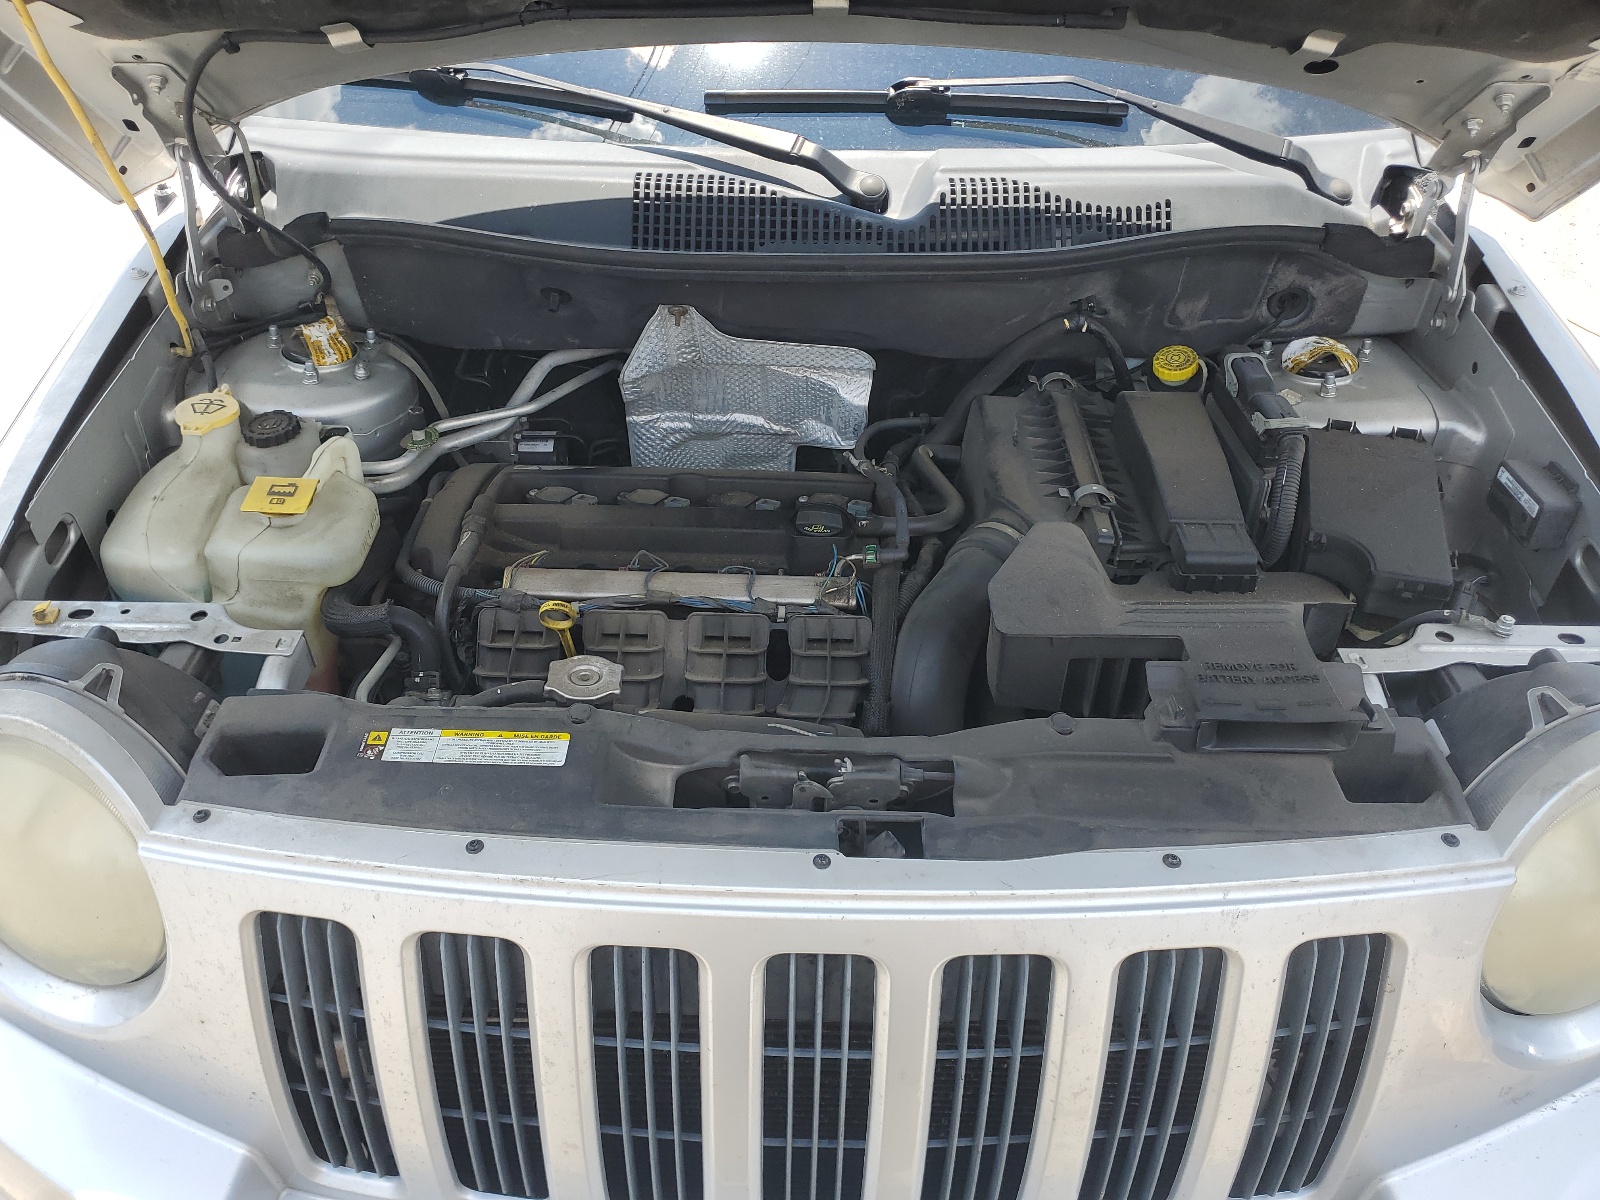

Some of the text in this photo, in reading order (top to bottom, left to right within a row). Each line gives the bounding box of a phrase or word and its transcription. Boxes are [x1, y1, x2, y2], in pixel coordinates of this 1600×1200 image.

[1203, 662, 1298, 672] REMOVE FOR
[1197, 674, 1320, 684] BATTERY ACCESS
